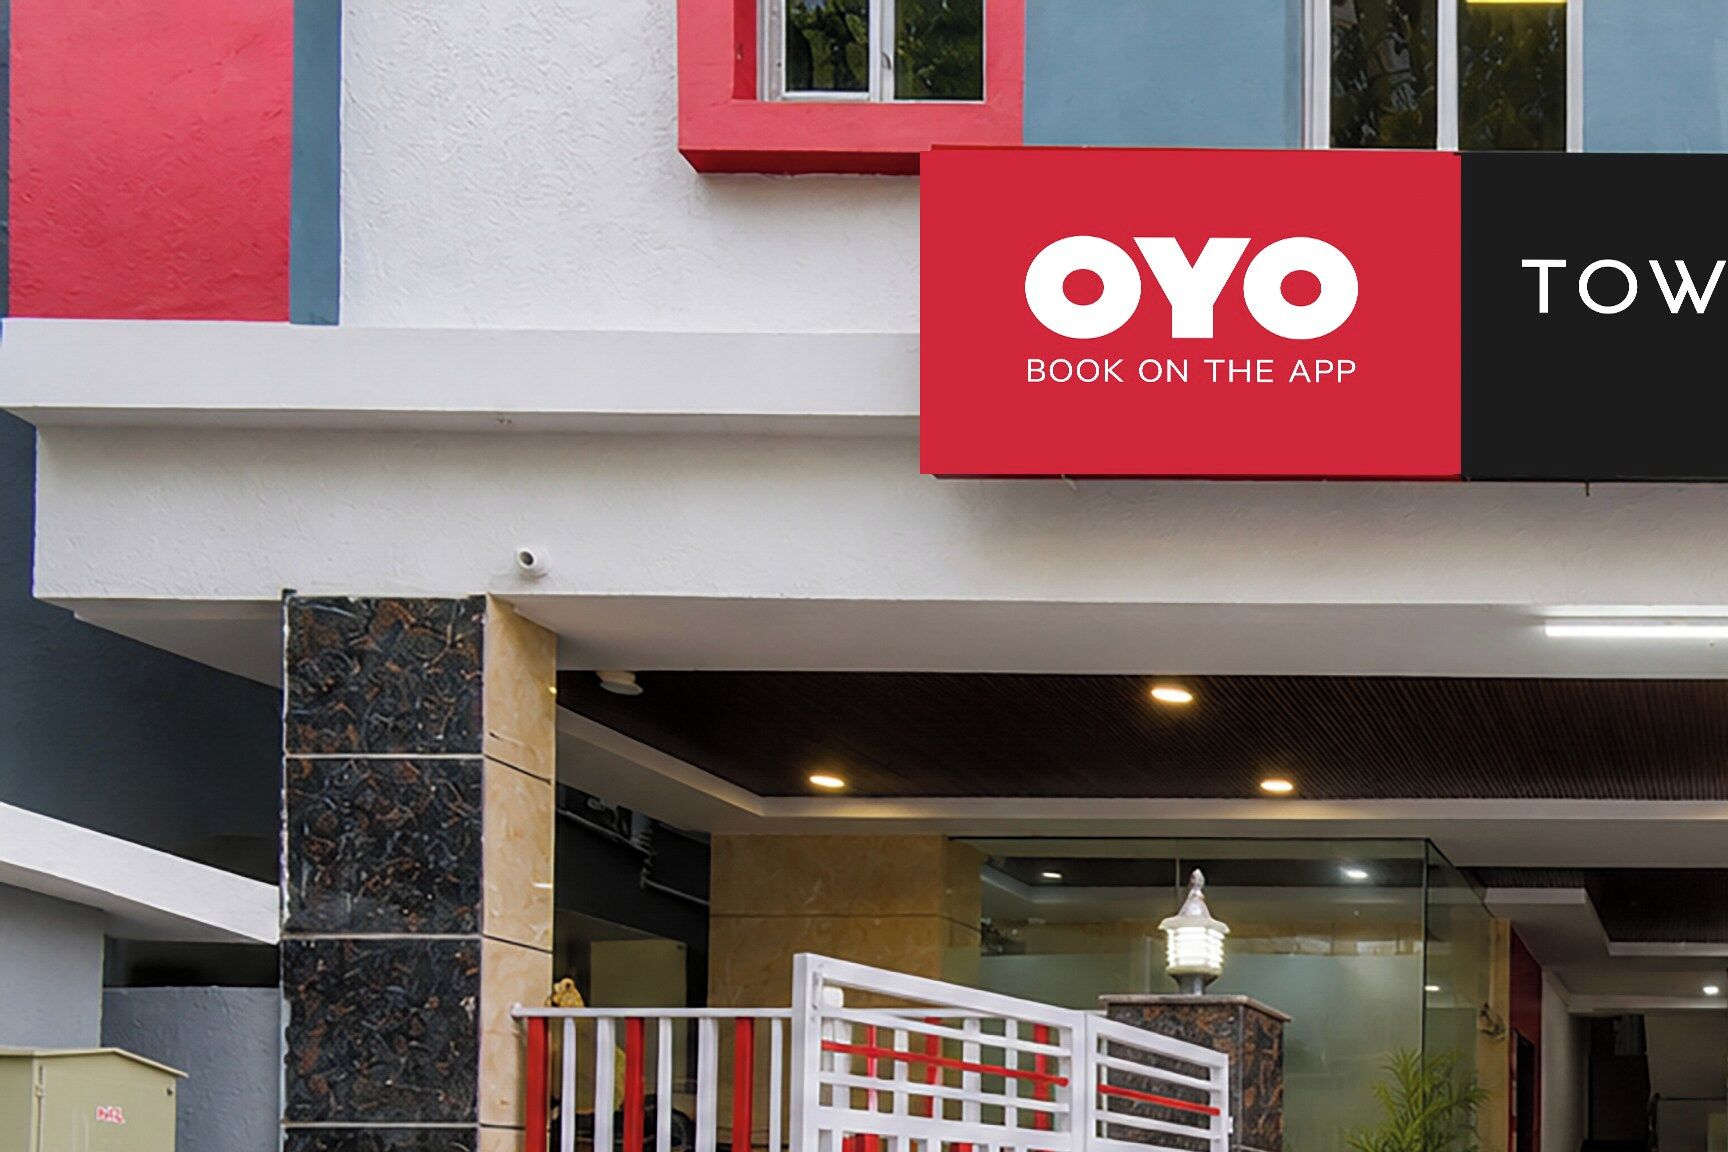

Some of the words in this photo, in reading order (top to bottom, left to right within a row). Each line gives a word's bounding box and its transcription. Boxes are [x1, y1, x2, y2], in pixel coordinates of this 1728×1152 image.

[1024, 235, 1359, 340] OYO
[1026, 358, 1125, 383] BOOK
[1138, 358, 1189, 383] ON
[1203, 358, 1275, 383] THE
[1288, 358, 1357, 383] APP
